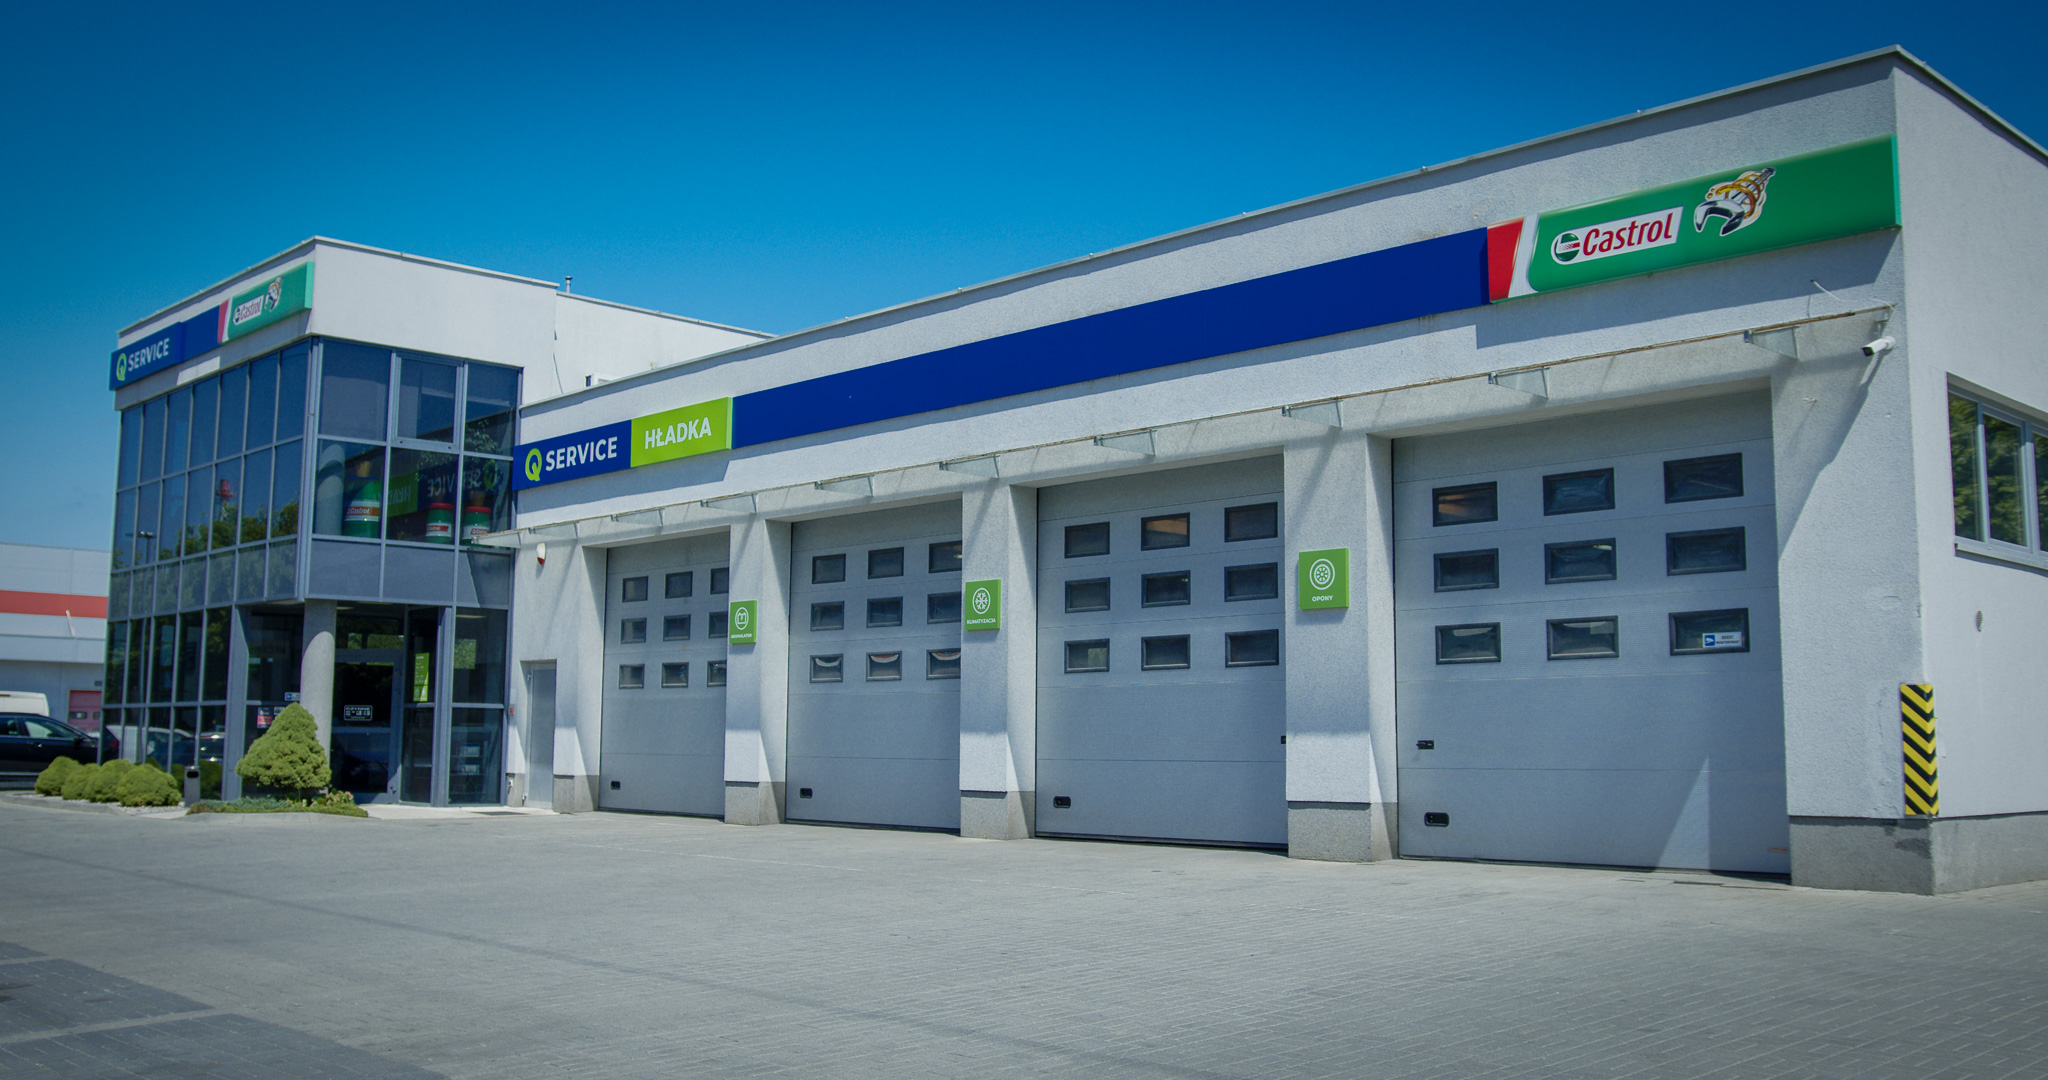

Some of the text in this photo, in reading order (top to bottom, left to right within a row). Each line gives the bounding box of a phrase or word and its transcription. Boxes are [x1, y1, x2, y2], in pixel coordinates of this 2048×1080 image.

[1583, 212, 1673, 256] Castrol
[240, 299, 262, 320] Castrol
[128, 338, 170, 371] SERVICE
[644, 417, 712, 450] HŁADKA
[525, 436, 618, 482] Q SERVICE
